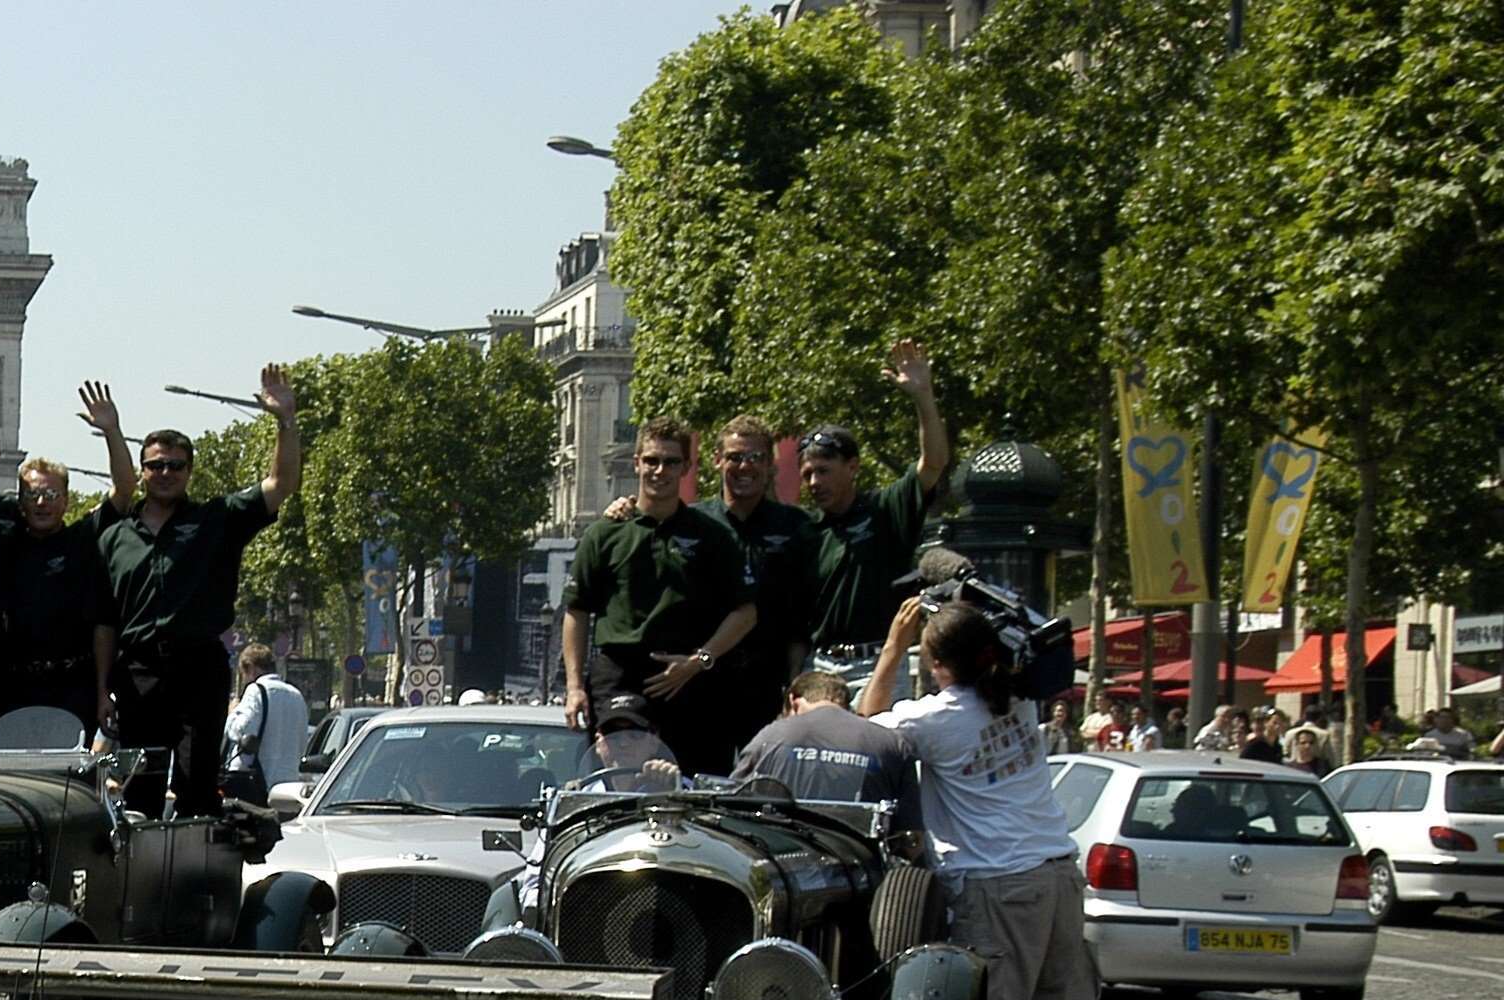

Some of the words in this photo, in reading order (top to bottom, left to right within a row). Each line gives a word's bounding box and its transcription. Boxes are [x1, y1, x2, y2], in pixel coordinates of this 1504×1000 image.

[1199, 932, 1230, 948] 854
[1234, 934, 1264, 949] NJA
[1270, 934, 1289, 950] 75
